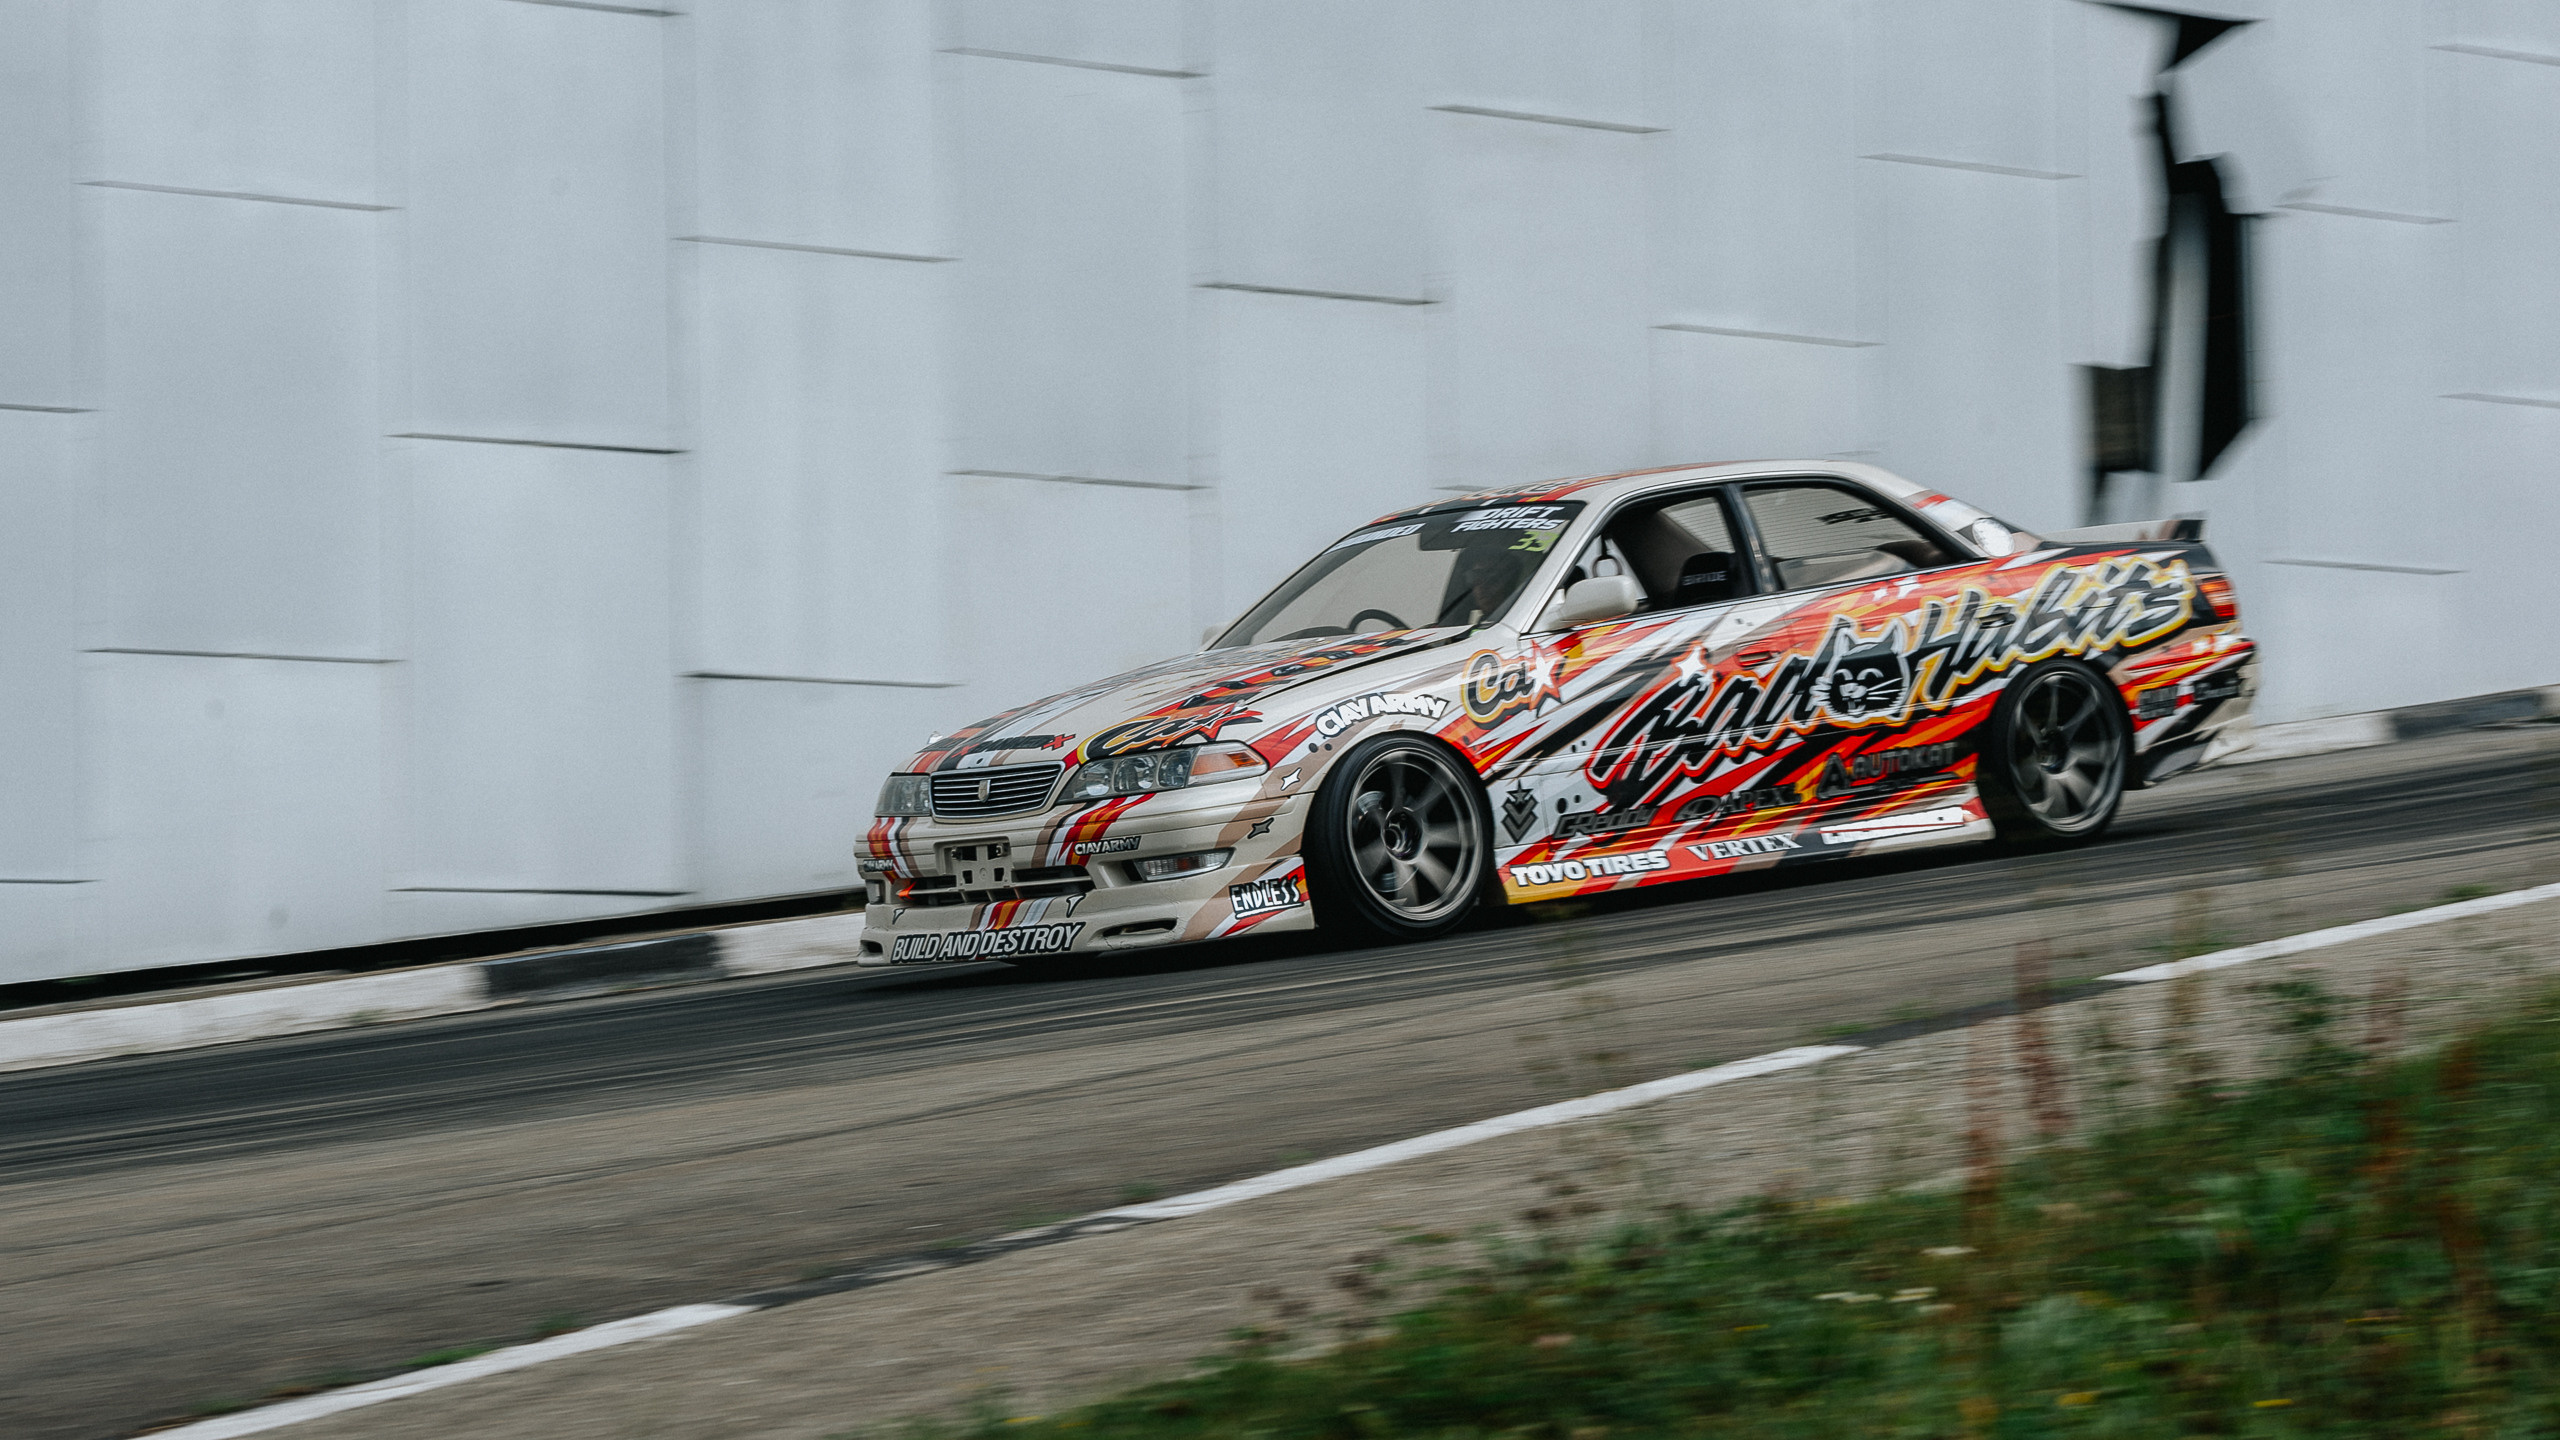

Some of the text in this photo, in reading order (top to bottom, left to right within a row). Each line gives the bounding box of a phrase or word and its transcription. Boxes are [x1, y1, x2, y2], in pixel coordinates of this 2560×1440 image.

[1451, 518, 1566, 532] FIGHTERS
[1481, 506, 1565, 519] DRIFT
[1508, 530, 1561, 552] 33
[1686, 833, 1802, 861] VERTEX
[1510, 850, 1670, 887] TOYO TIRES
[1230, 877, 1302, 912] ENDLESS
[892, 924, 1082, 961] BUILD AND DESTROY
